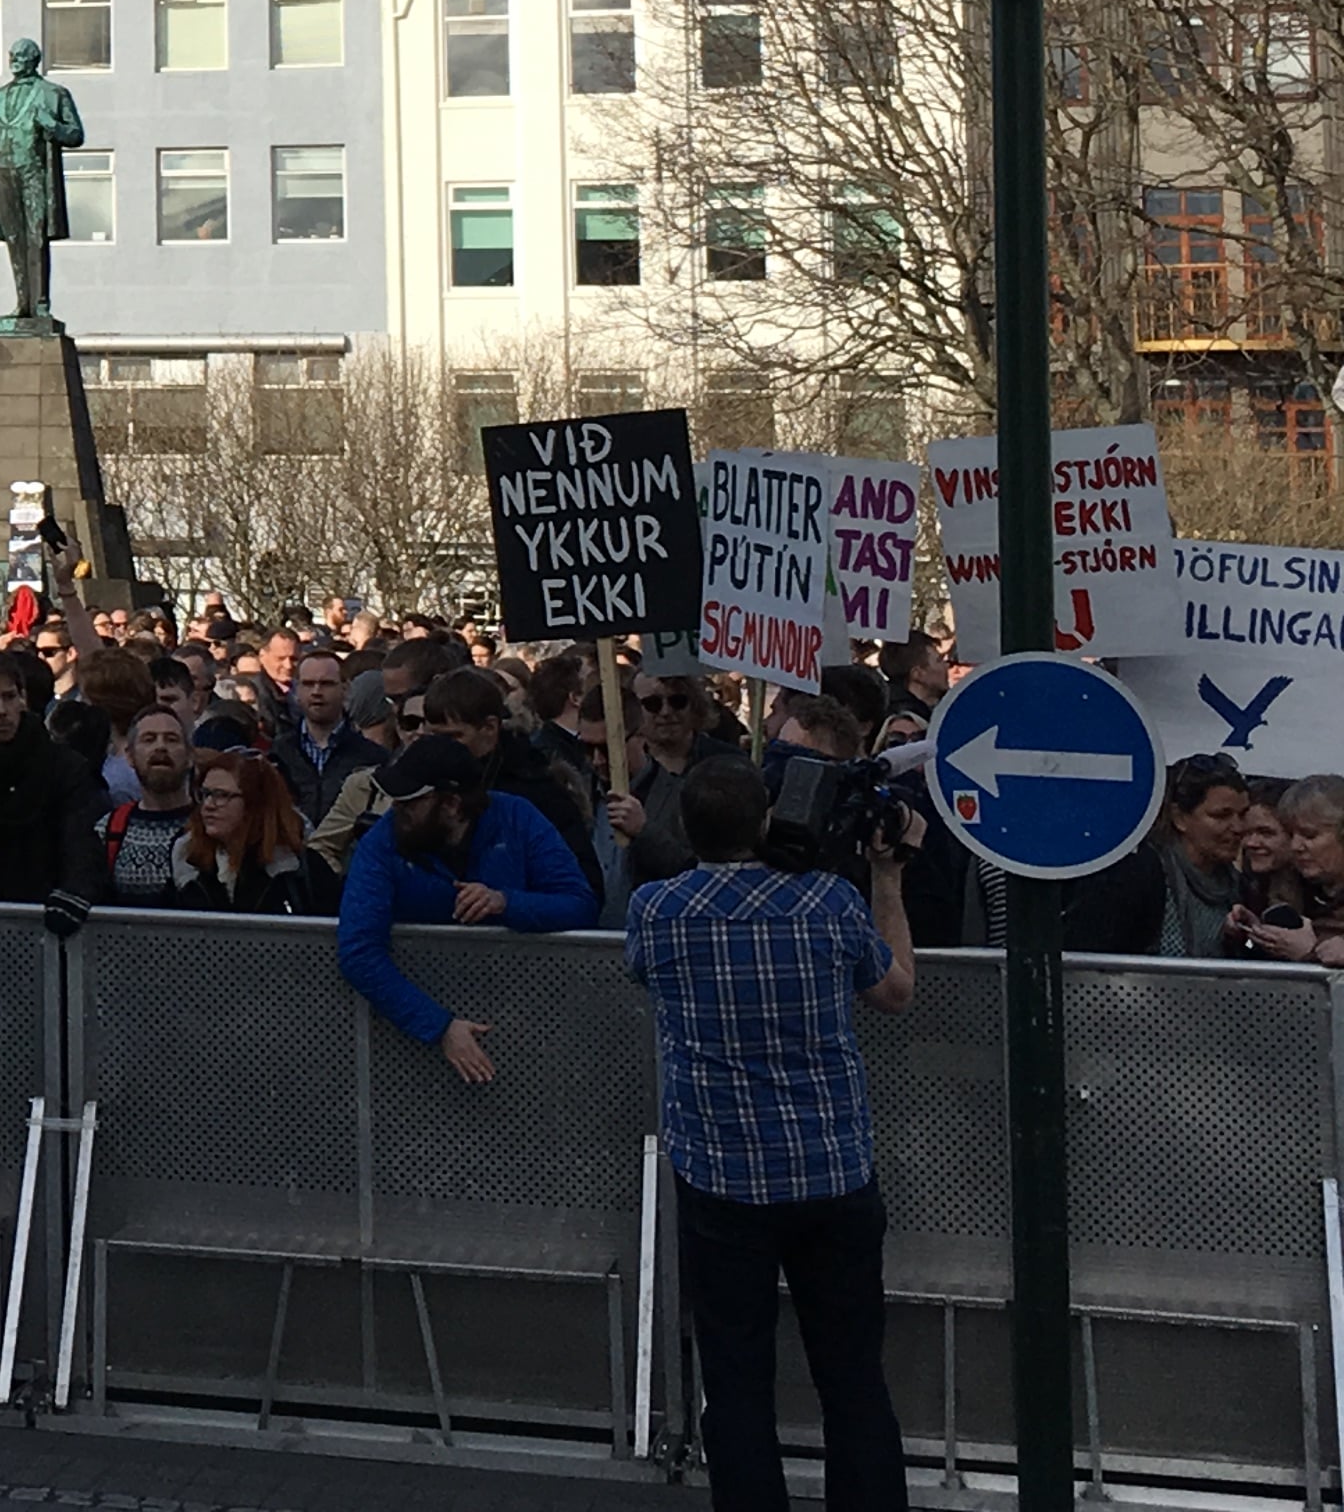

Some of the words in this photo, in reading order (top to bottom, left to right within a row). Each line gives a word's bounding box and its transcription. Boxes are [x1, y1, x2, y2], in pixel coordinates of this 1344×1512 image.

[529, 423, 613, 466] VIÐ
[499, 454, 681, 517] NENNUM
[713, 460, 822, 544] BLATTER
[514, 514, 669, 572] YKKUR
[708, 534, 812, 603] PÚTÍN
[541, 572, 647, 627] EKKI
[1185, 600, 1344, 652] ILLINGA
[701, 600, 823, 682] SIGMUNDUR
